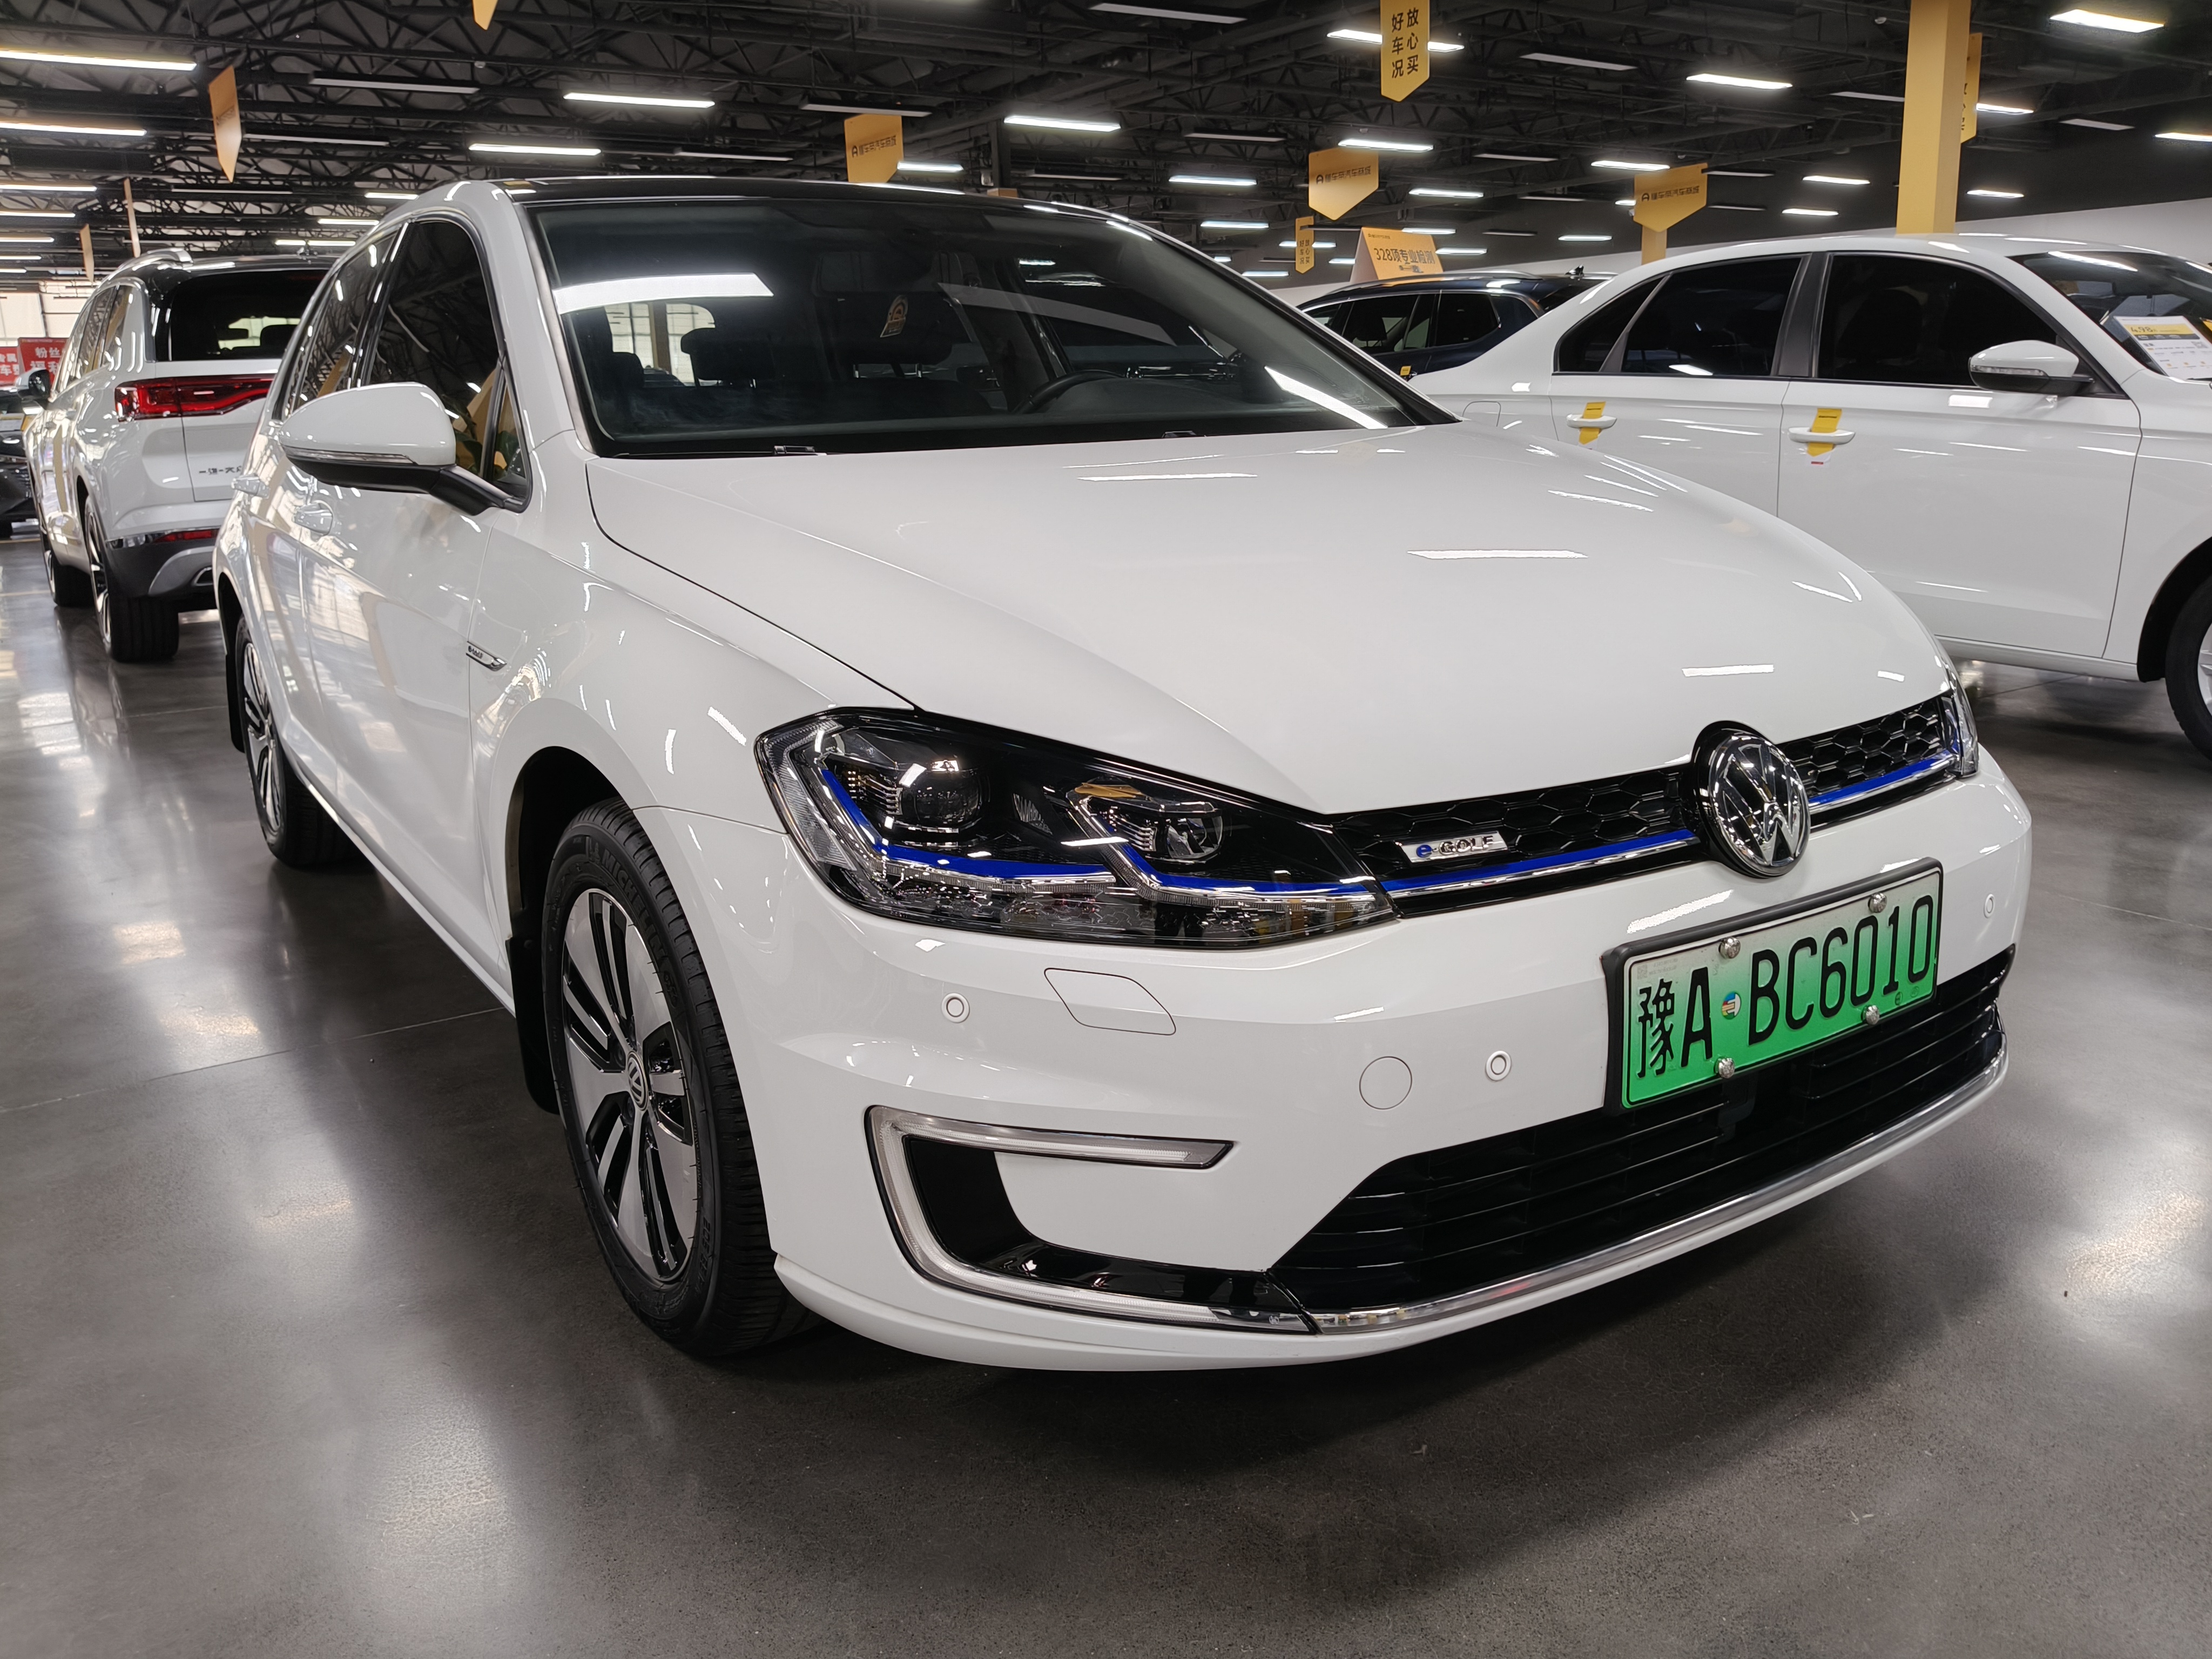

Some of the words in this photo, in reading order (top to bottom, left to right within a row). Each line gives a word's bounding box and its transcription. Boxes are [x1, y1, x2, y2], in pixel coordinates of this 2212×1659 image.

[1392, 12, 1404, 78] 好车况
[1407, 8, 1419, 75] 放心买
[1373, 248, 1435, 264] 328项专业检测
[1748, 895, 1933, 1046] BC6010
